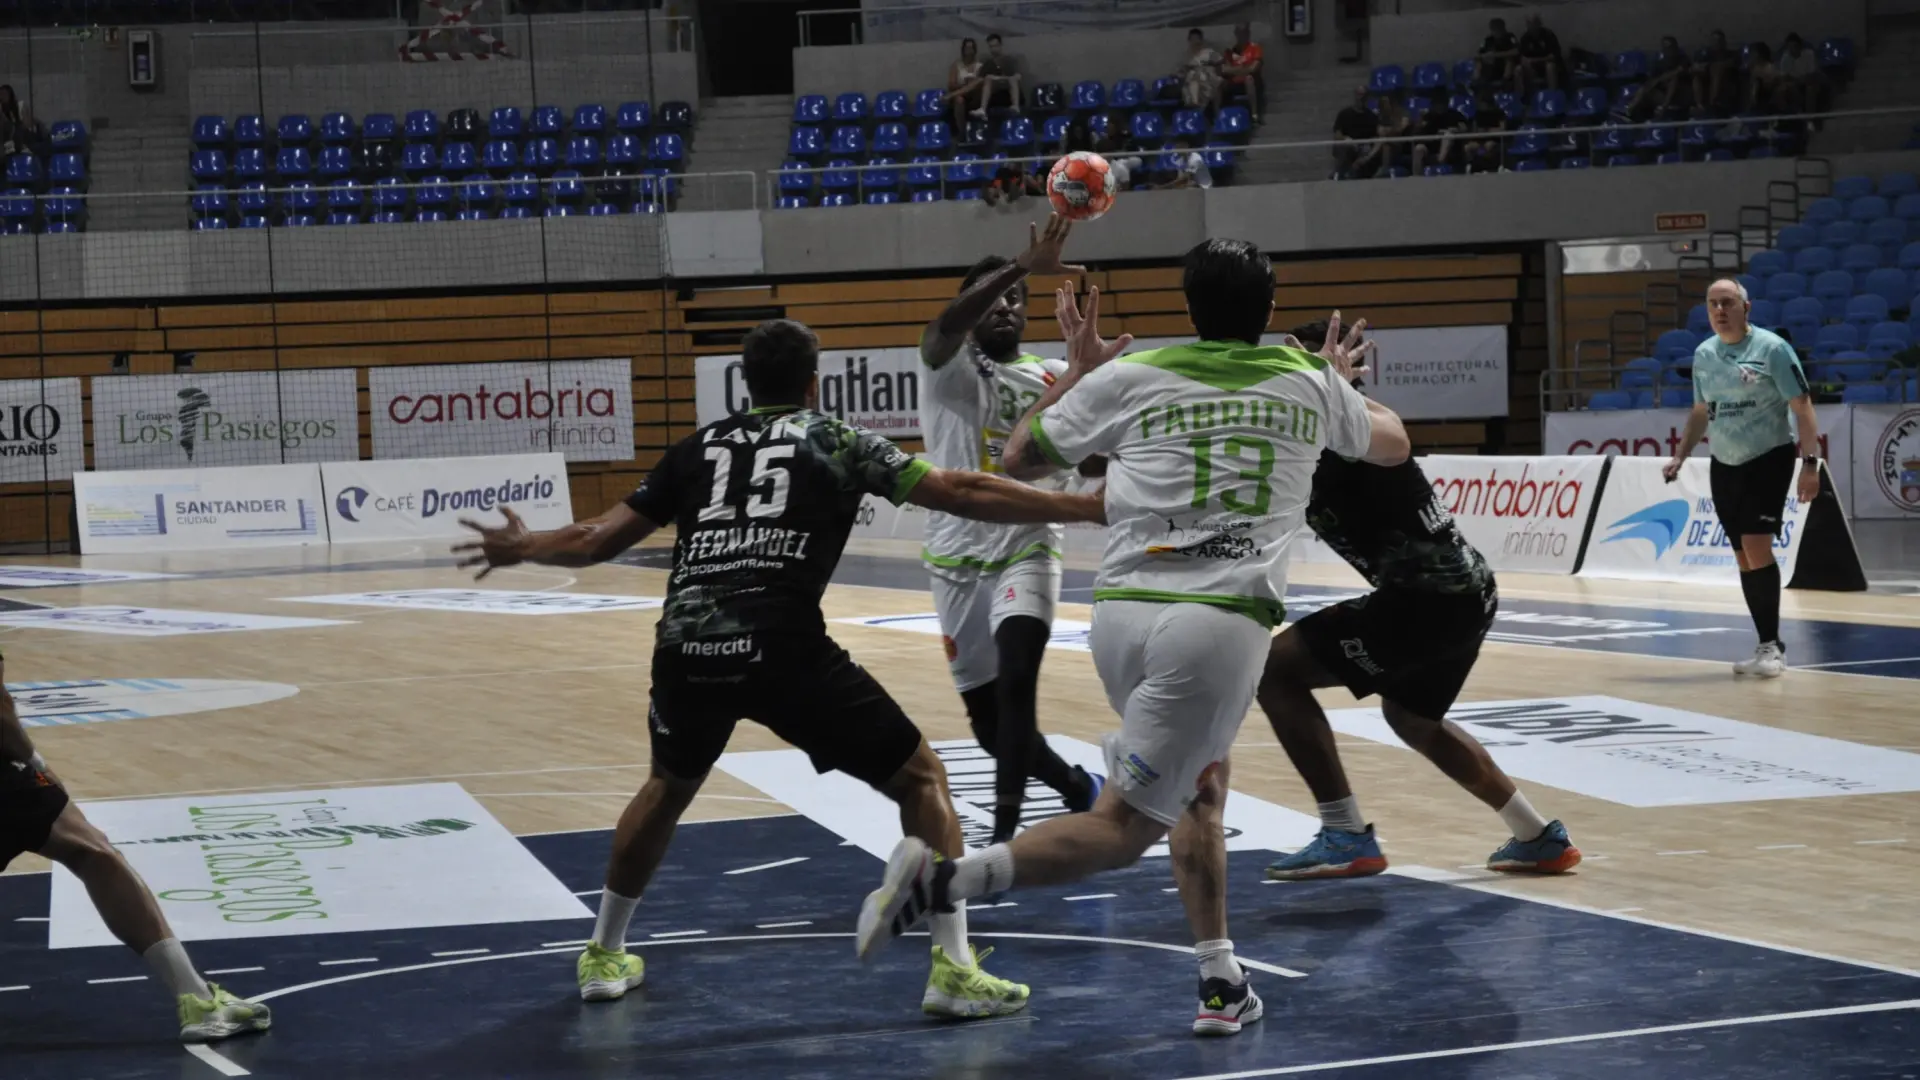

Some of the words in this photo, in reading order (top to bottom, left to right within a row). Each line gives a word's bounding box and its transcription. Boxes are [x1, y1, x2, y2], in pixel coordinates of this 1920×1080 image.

[1385, 359, 1499, 372] ARCHITECTURAL
[1385, 373, 1477, 386] TERRACOTTA
[135, 410, 173, 423] Grupo
[389, 378, 614, 424] cantabria
[117, 413, 173, 445] Los
[201, 410, 336, 448] Pasiegos
[530, 421, 616, 447] infinita
[1140, 400, 1318, 446] FABRICIO
[697, 444, 796, 522] 15
[1188, 435, 1275, 516] 13
[176, 499, 287, 515] SANTANDER
[375, 492, 416, 512] CAFÉ
[421, 474, 554, 519] Dromedario
[177, 515, 217, 525] CIUDAD
[688, 522, 811, 562] FERNÁNDEZ
[1503, 521, 1568, 557] infinita
[188, 798, 327, 831] Los
